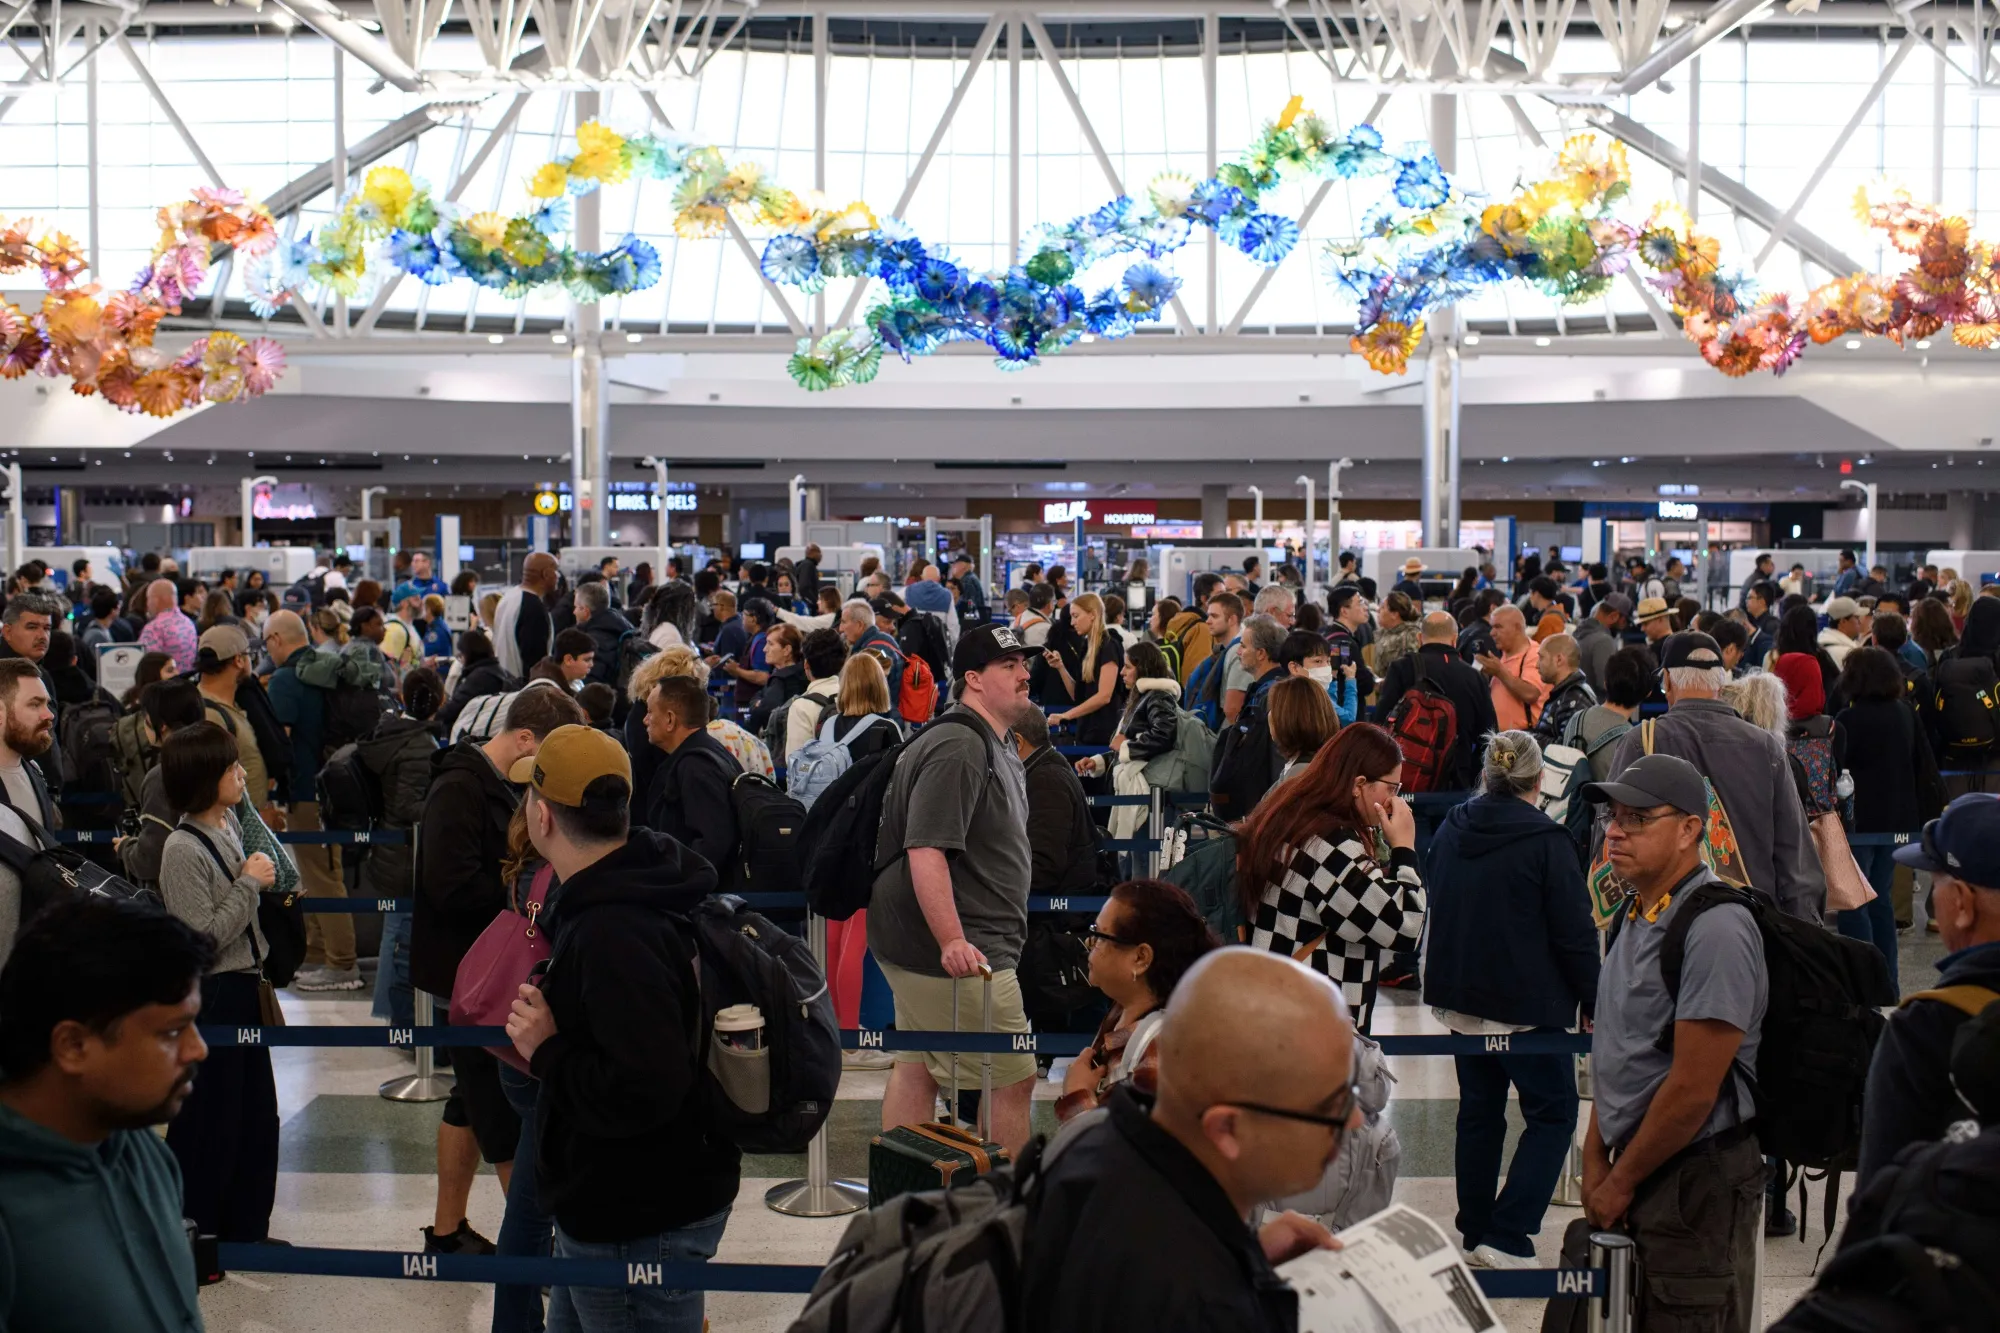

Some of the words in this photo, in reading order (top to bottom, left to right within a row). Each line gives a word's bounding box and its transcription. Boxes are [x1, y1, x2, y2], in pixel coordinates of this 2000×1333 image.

[650, 494, 698, 511] BGELS
[1103, 513, 1155, 525] HOUSTON
[77, 831, 93, 842] IAH
[354, 832, 370, 843] IAH
[1894, 833, 1909, 844] IAH
[377, 899, 396, 911] IAH
[1050, 898, 1068, 910] IAH
[237, 1028, 261, 1044] IAH
[389, 1028, 413, 1044] IAH
[859, 1031, 883, 1047] IAH
[1012, 1034, 1037, 1051] IAH
[1485, 1035, 1510, 1052] IAH
[403, 1254, 438, 1277] IAH
[627, 1262, 663, 1285] IAH
[1556, 1270, 1593, 1294] IAH
